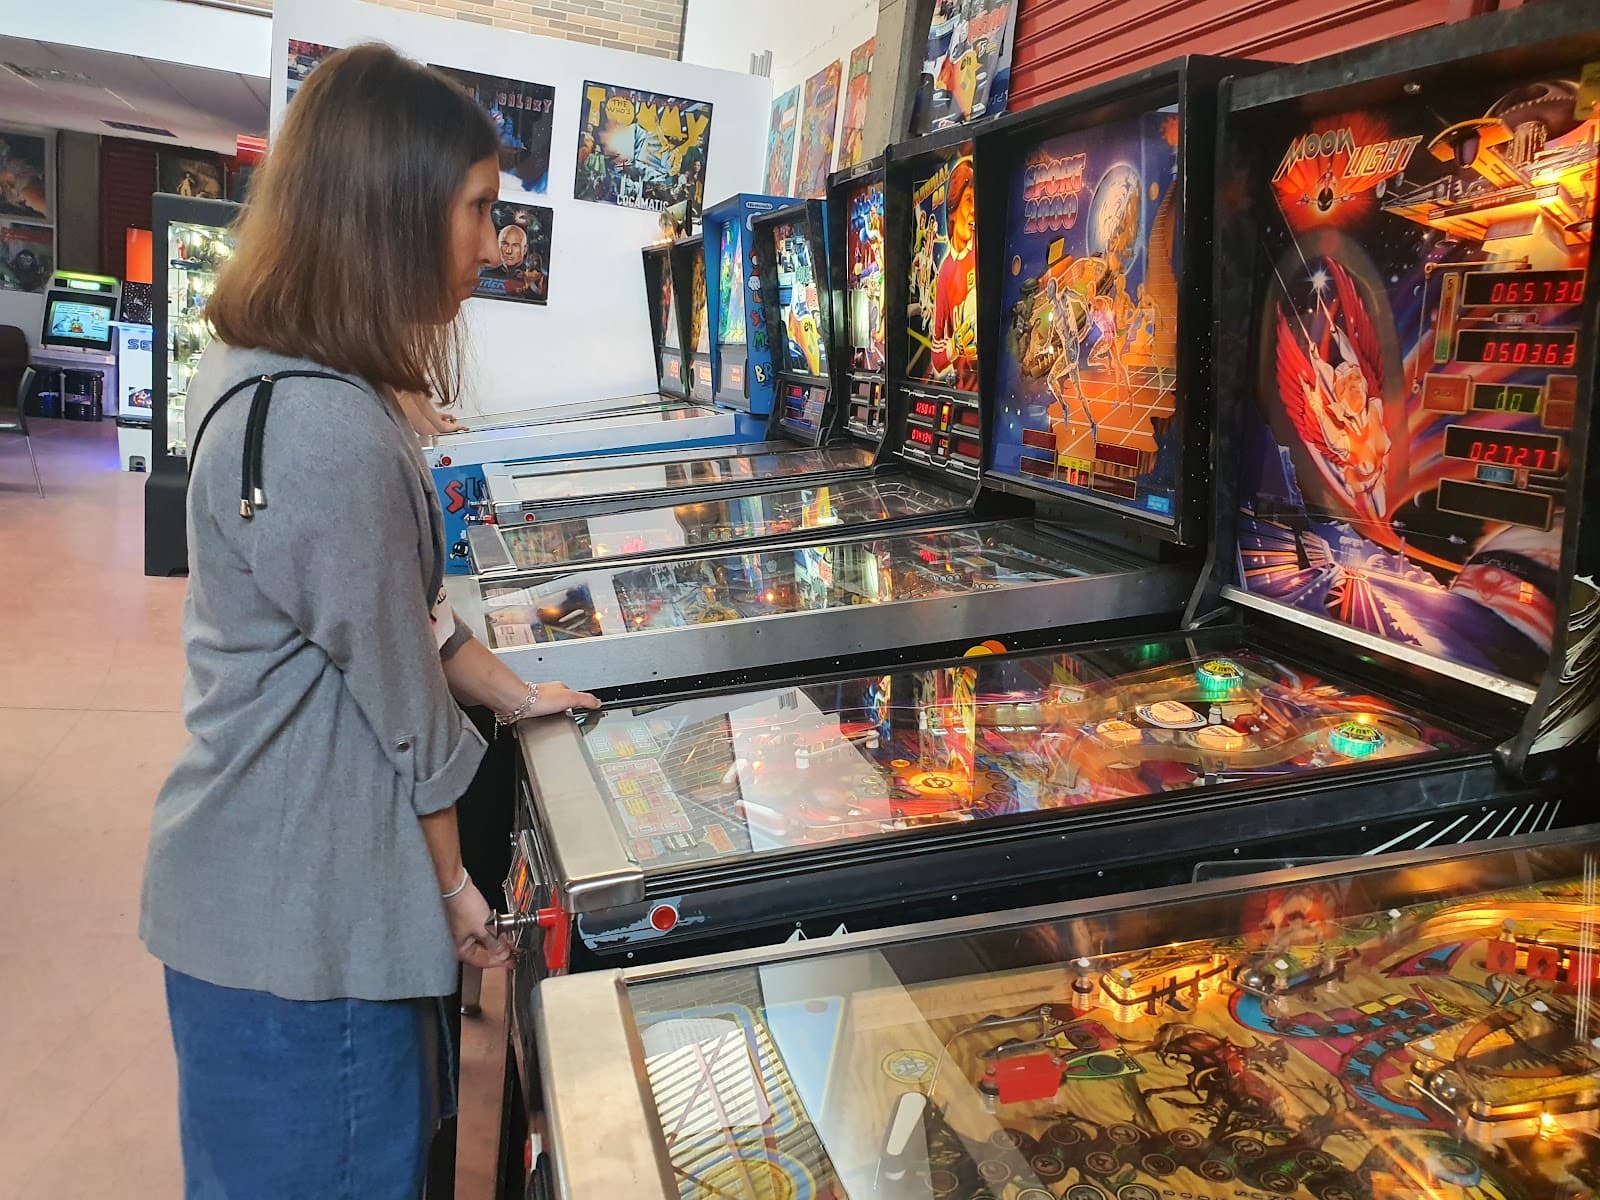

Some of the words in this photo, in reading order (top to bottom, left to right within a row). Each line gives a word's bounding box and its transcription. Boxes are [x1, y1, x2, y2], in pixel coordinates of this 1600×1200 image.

[498, 92, 552, 113] GALAXY
[586, 86, 709, 156] TOMMY
[612, 99, 628, 107] THE
[1272, 128, 1355, 182] MOON
[1344, 136, 1424, 179] LIGHT
[912, 162, 949, 209] MUNDIAL
[1024, 192, 1078, 235] 2000
[1490, 280, 1583, 304] 065730
[1483, 342, 1576, 366] 050363
